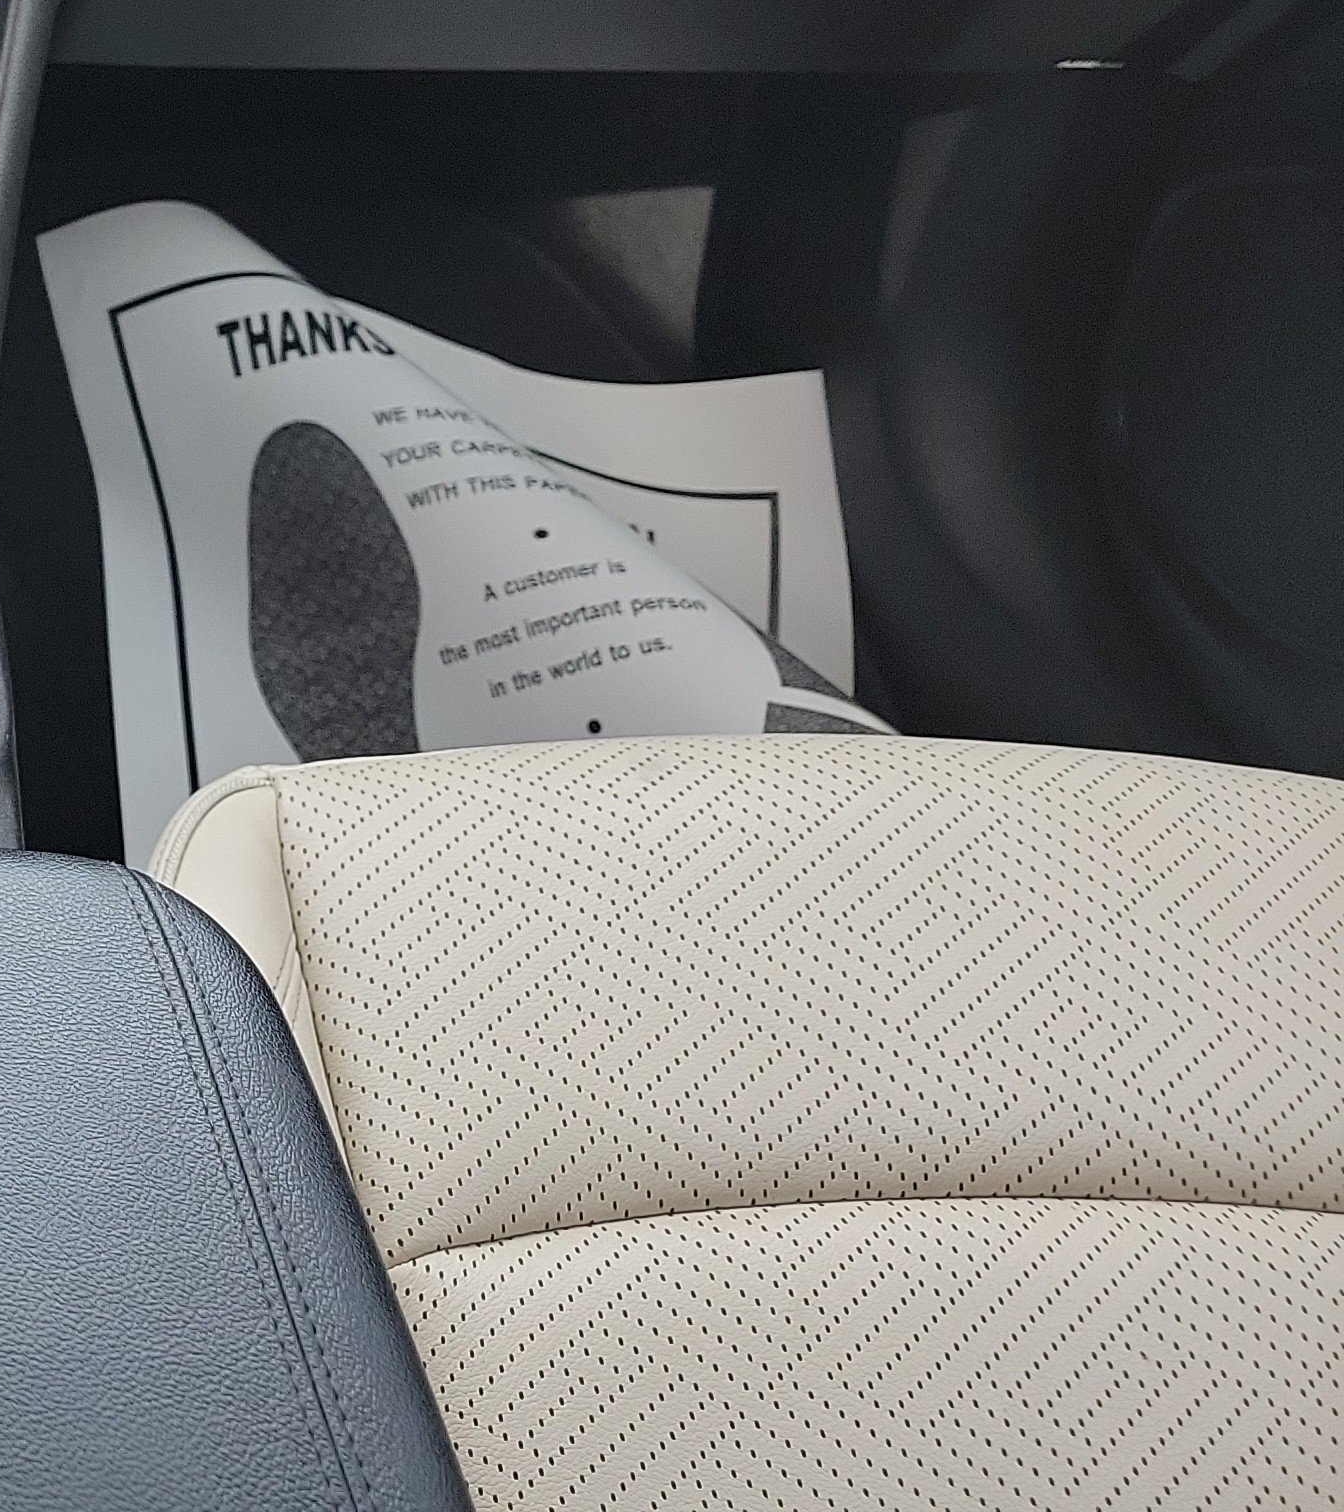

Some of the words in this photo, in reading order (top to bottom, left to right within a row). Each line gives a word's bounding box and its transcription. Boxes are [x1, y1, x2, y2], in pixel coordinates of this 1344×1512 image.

[372, 406, 408, 426] WE
[381, 441, 441, 468] YOUR
[405, 482, 459, 510] WITH
[466, 475, 516, 494] THIS
[484, 583, 498, 602] A
[504, 562, 598, 596] customer
[608, 560, 626, 574] is
[439, 645, 469, 666] the
[474, 626, 520, 655] most
[525, 600, 623, 638] important
[631, 597, 707, 617] person
[488, 680, 507, 698] in
[512, 671, 542, 690] the
[548, 649, 602, 678] world
[609, 644, 630, 662] to
[638, 638, 672, 654] us.
